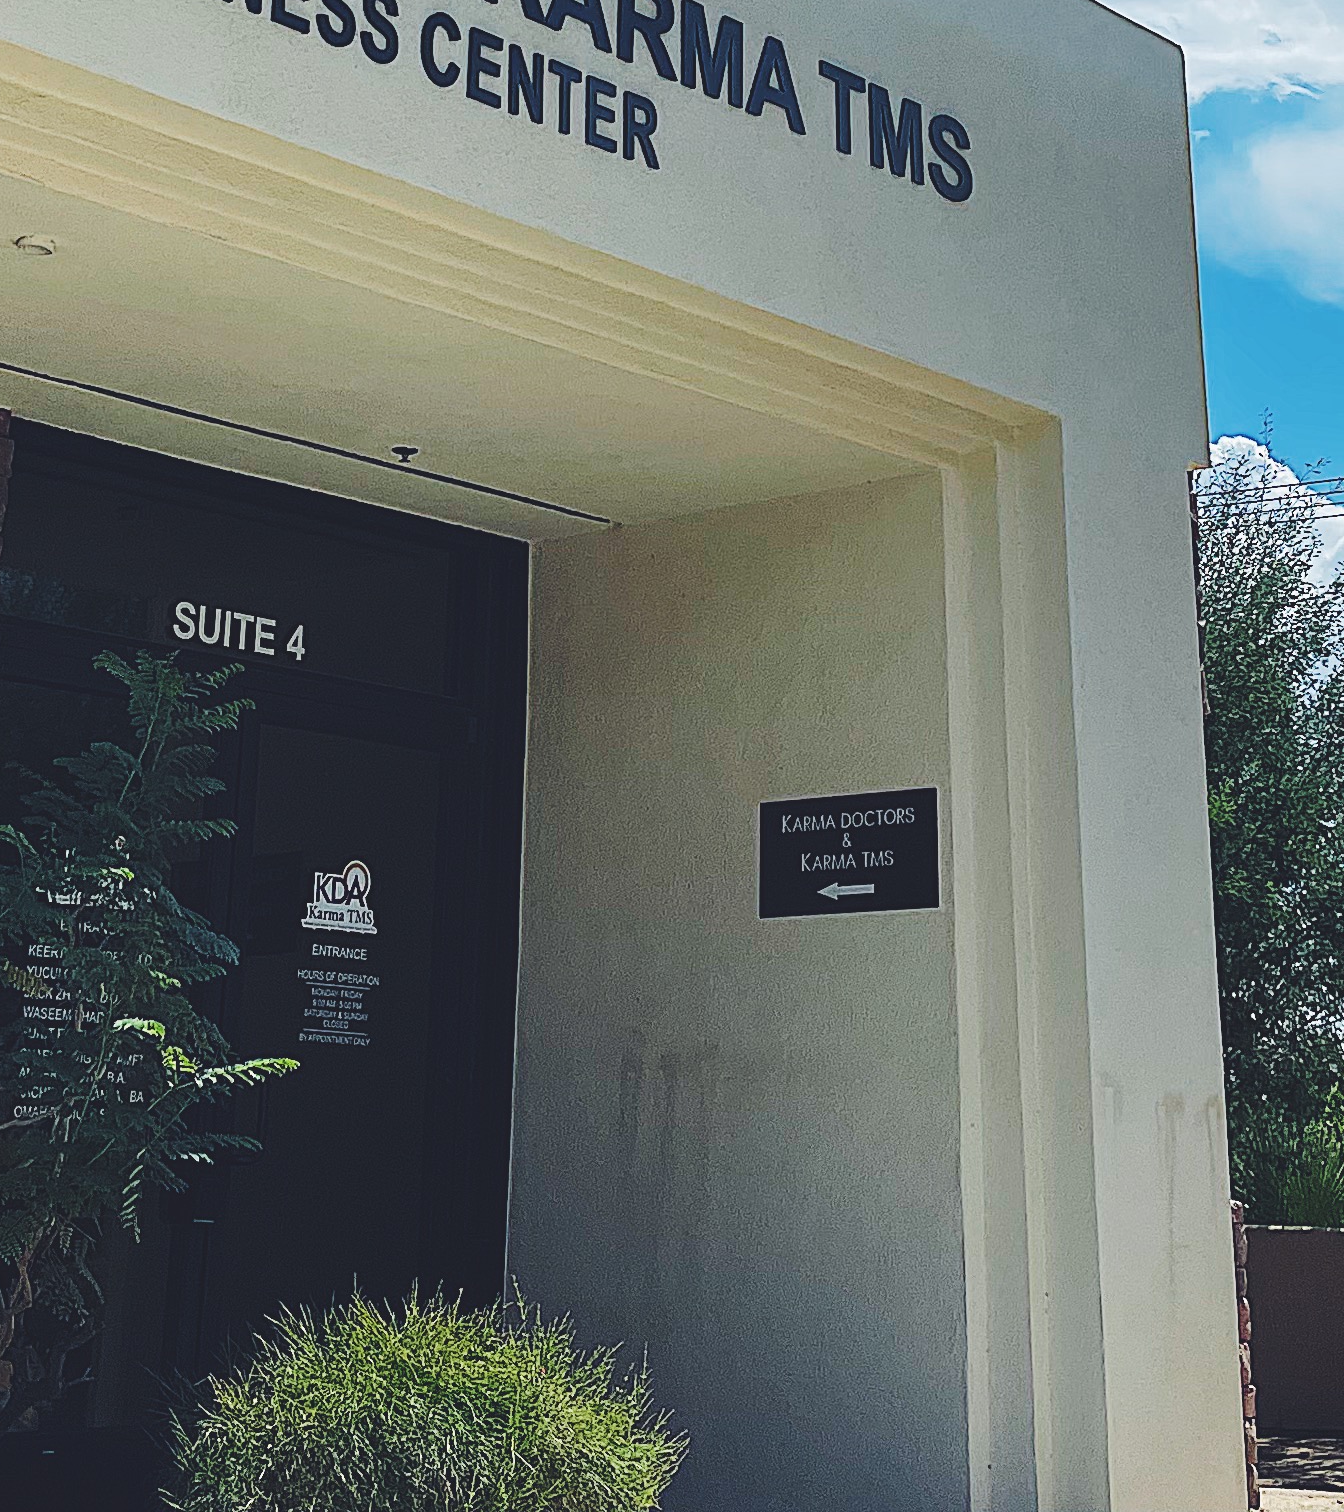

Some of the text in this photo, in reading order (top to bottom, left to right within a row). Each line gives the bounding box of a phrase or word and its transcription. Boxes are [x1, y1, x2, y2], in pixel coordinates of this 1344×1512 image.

[419, 11, 660, 170] CENTER
[817, 59, 975, 203] TMS
[172, 601, 306, 661] SUITE 4
[781, 807, 915, 834] KARMA DOCTORS
[842, 832, 852, 848] &
[801, 849, 894, 872] KARMA TMS
[315, 873, 366, 908] KDA
[308, 904, 373, 925] Karma TMS
[312, 944, 368, 960] ENTRANCE
[297, 969, 380, 986] HOURS OF OPERATION
[23, 1006, 72, 1021] WASEEM
